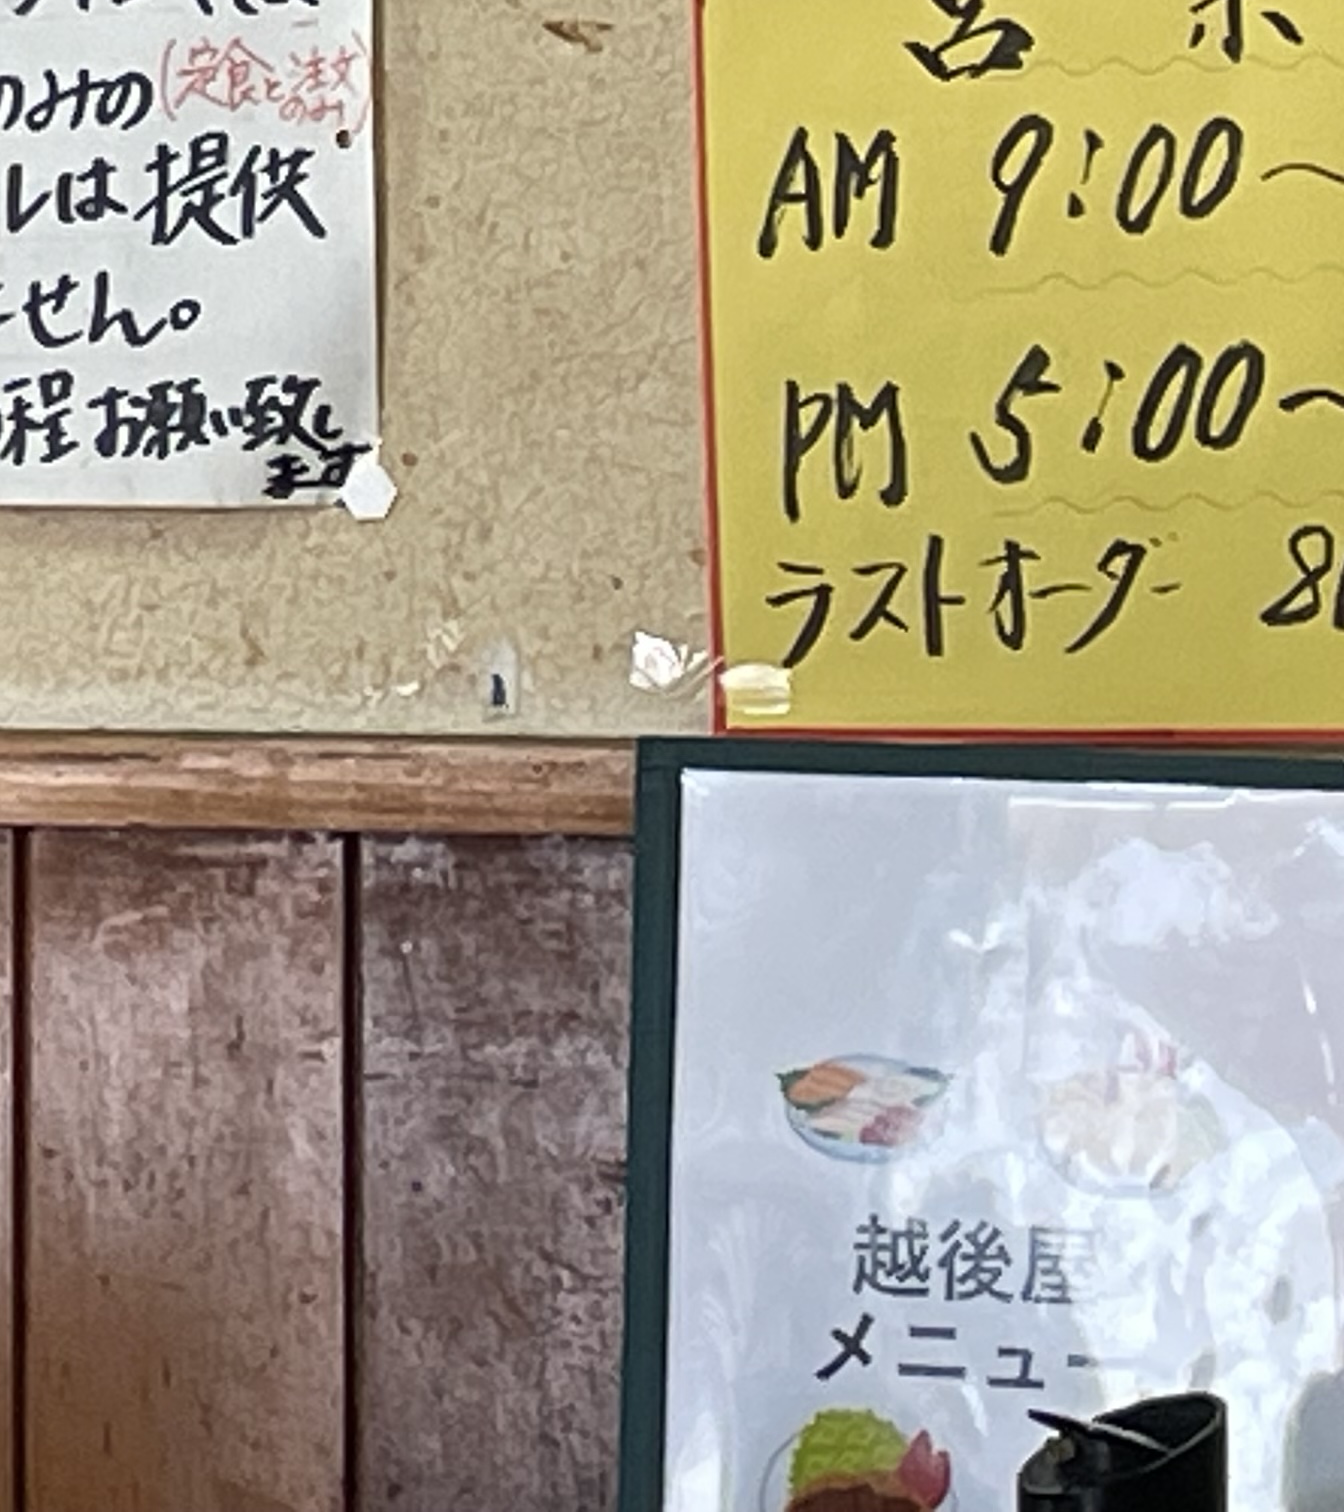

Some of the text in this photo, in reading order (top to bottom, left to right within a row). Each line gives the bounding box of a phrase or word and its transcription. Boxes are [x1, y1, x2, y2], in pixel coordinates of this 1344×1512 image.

[757, 125, 900, 260] AM
[782, 379, 908, 523] PM
[763, 531, 1181, 668] ラストオーダー
[852, 1212, 1096, 1305] 越後屋
